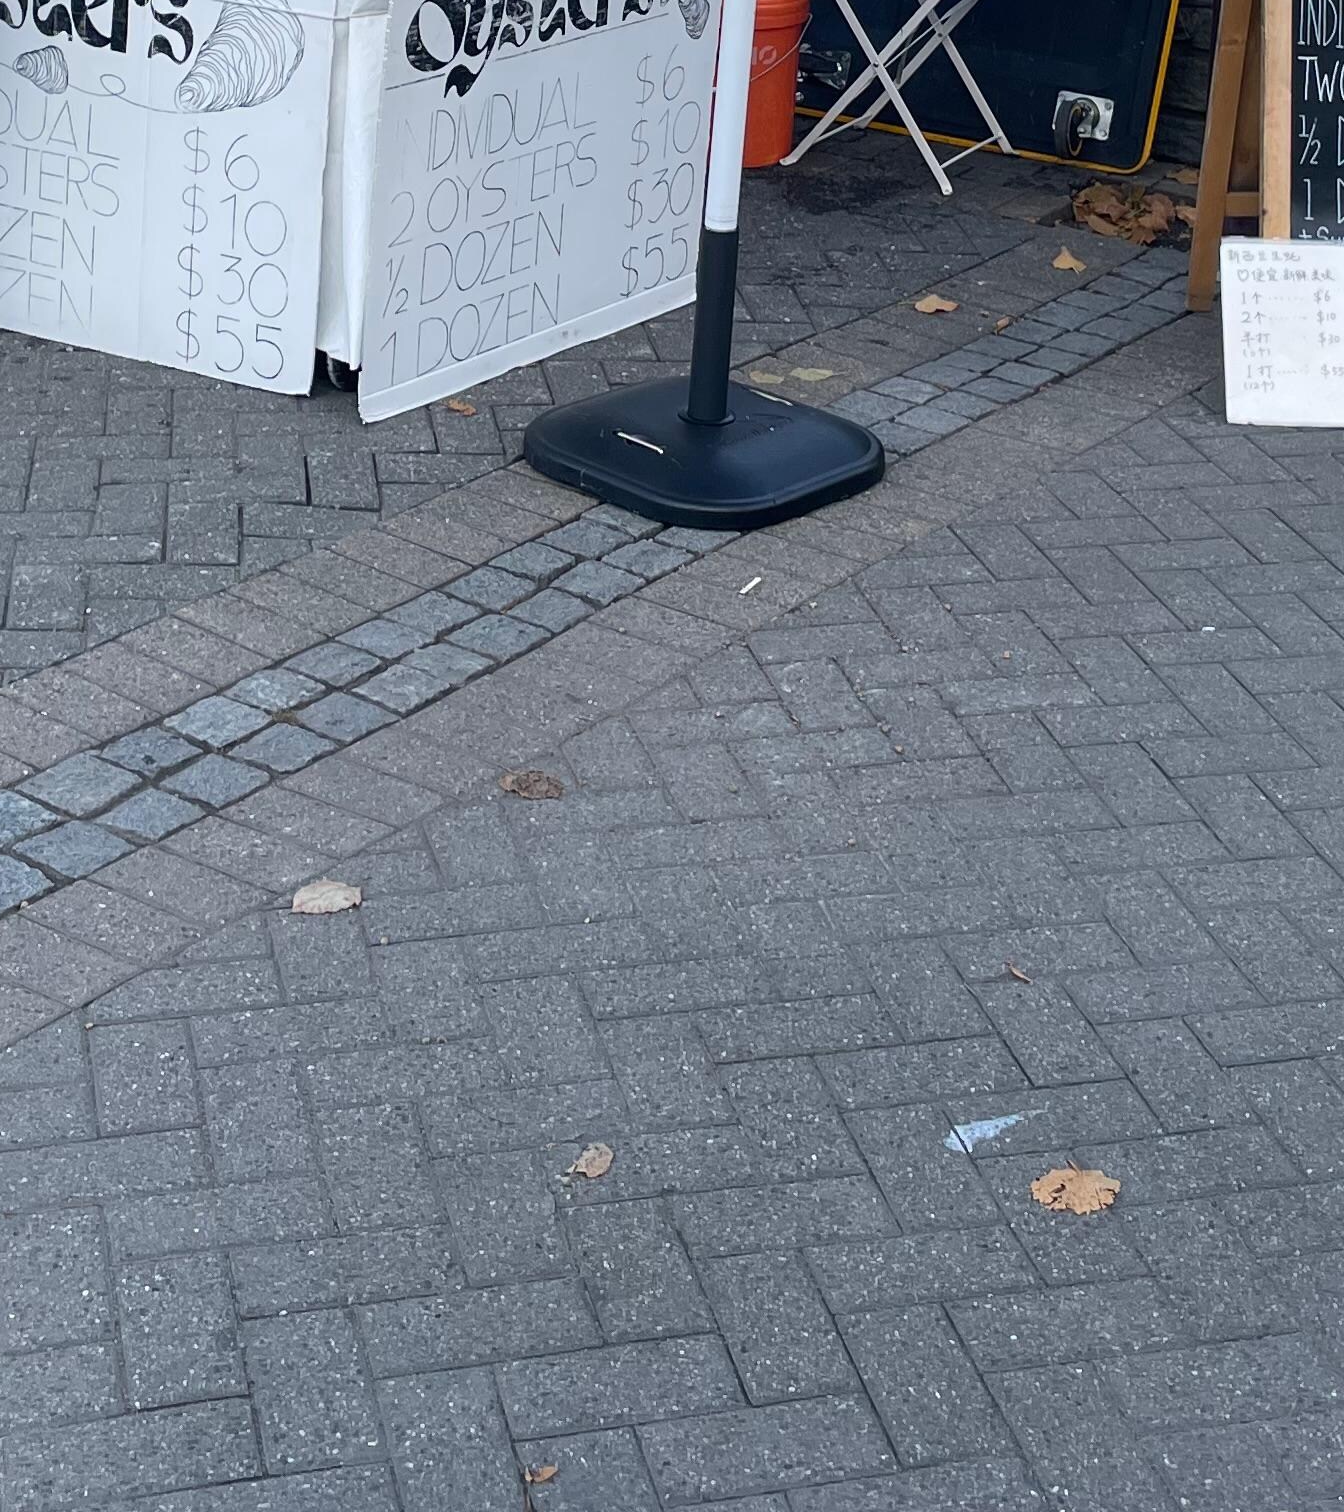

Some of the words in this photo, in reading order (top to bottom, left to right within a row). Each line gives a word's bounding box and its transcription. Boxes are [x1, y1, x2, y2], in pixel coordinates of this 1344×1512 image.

[388, 191, 415, 248] 2
[426, 132, 598, 233] OYSTERS
[630, 101, 701, 168] $10
[420, 203, 565, 305] DOZEN
[624, 162, 695, 230] $30
[1303, 179, 1315, 220] 1
[380, 331, 396, 385] 1
[417, 274, 561, 377] DOZEN
[620, 223, 689, 298] $55
[1317, 311, 1336, 324] $10
